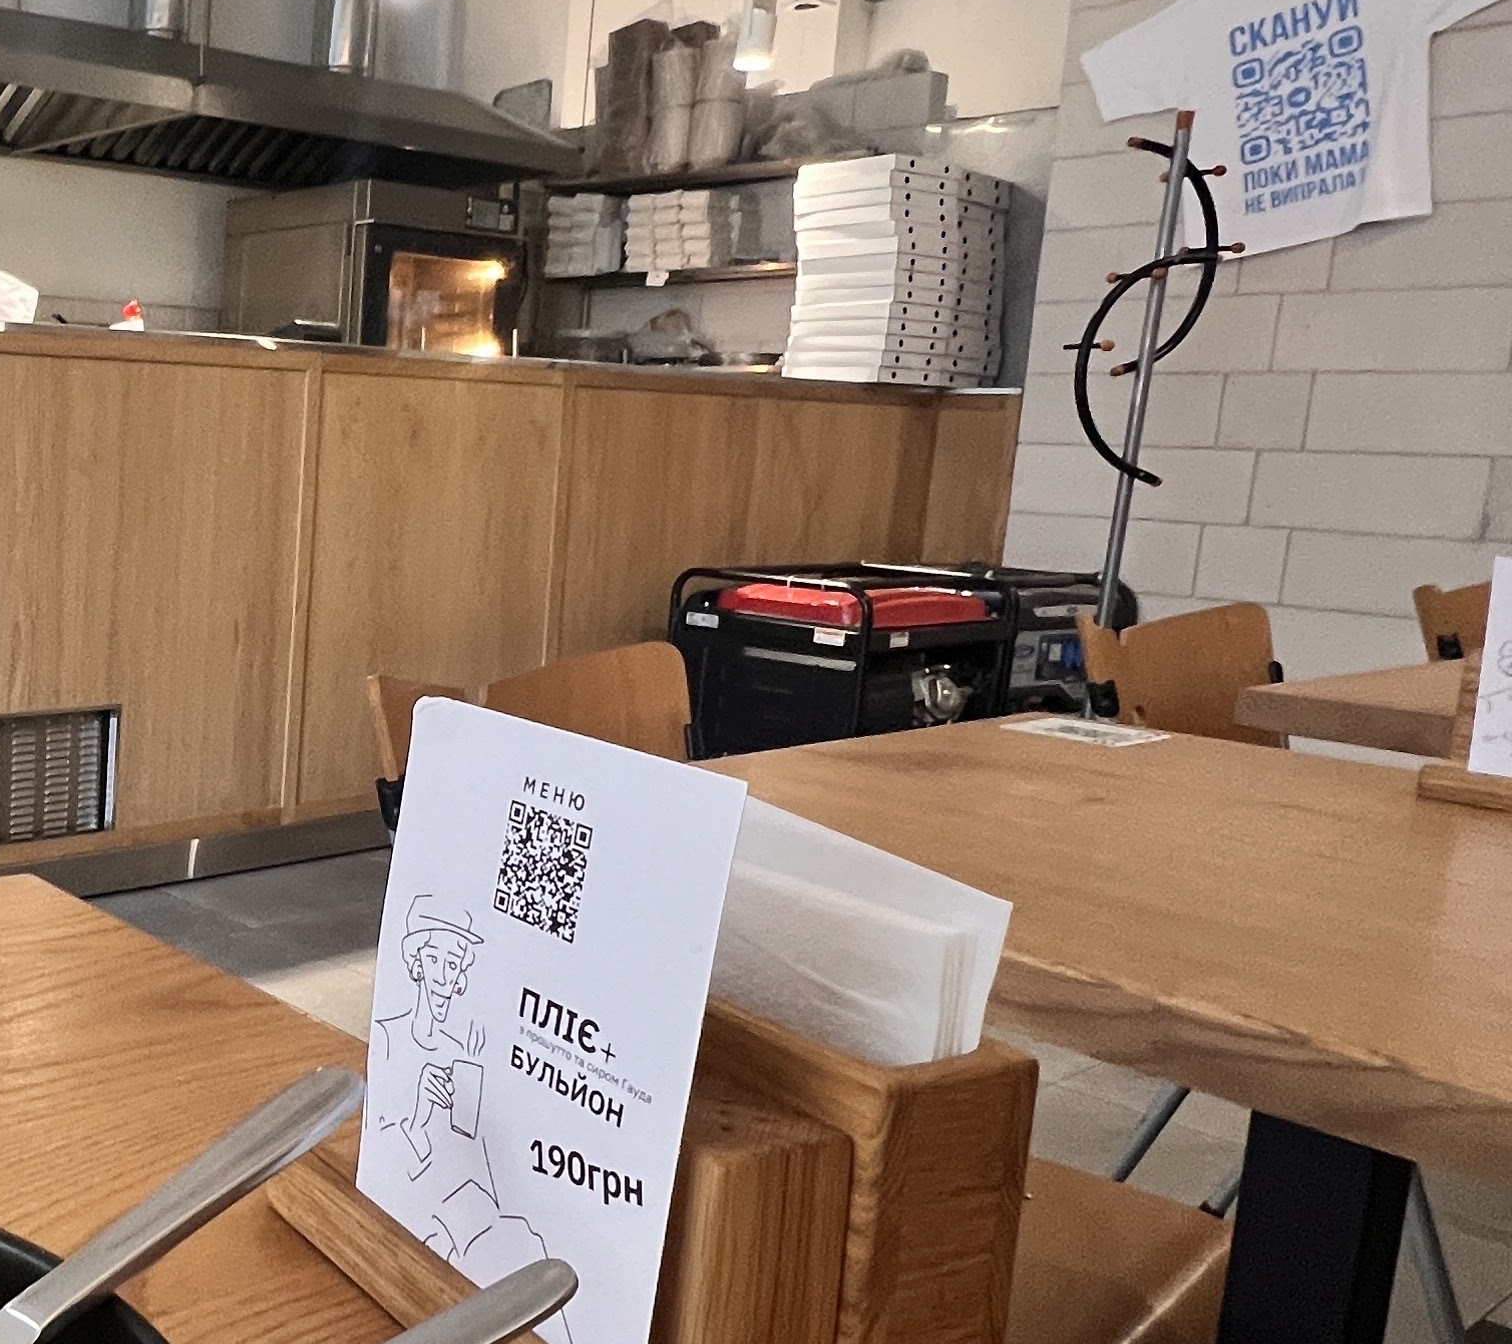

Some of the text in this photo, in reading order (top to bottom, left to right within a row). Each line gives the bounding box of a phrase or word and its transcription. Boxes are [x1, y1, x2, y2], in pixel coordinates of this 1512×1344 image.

[1243, 139, 1370, 193] ПОКИ МАМА
[1244, 192, 1266, 216] НЕ
[523, 776, 585, 811] МЕНЮ
[511, 1044, 625, 1128] БУЛЬЙОН
[574, 1054, 585, 1068] та
[586, 1062, 619, 1087] сиром
[530, 1139, 643, 1207] 190грн
